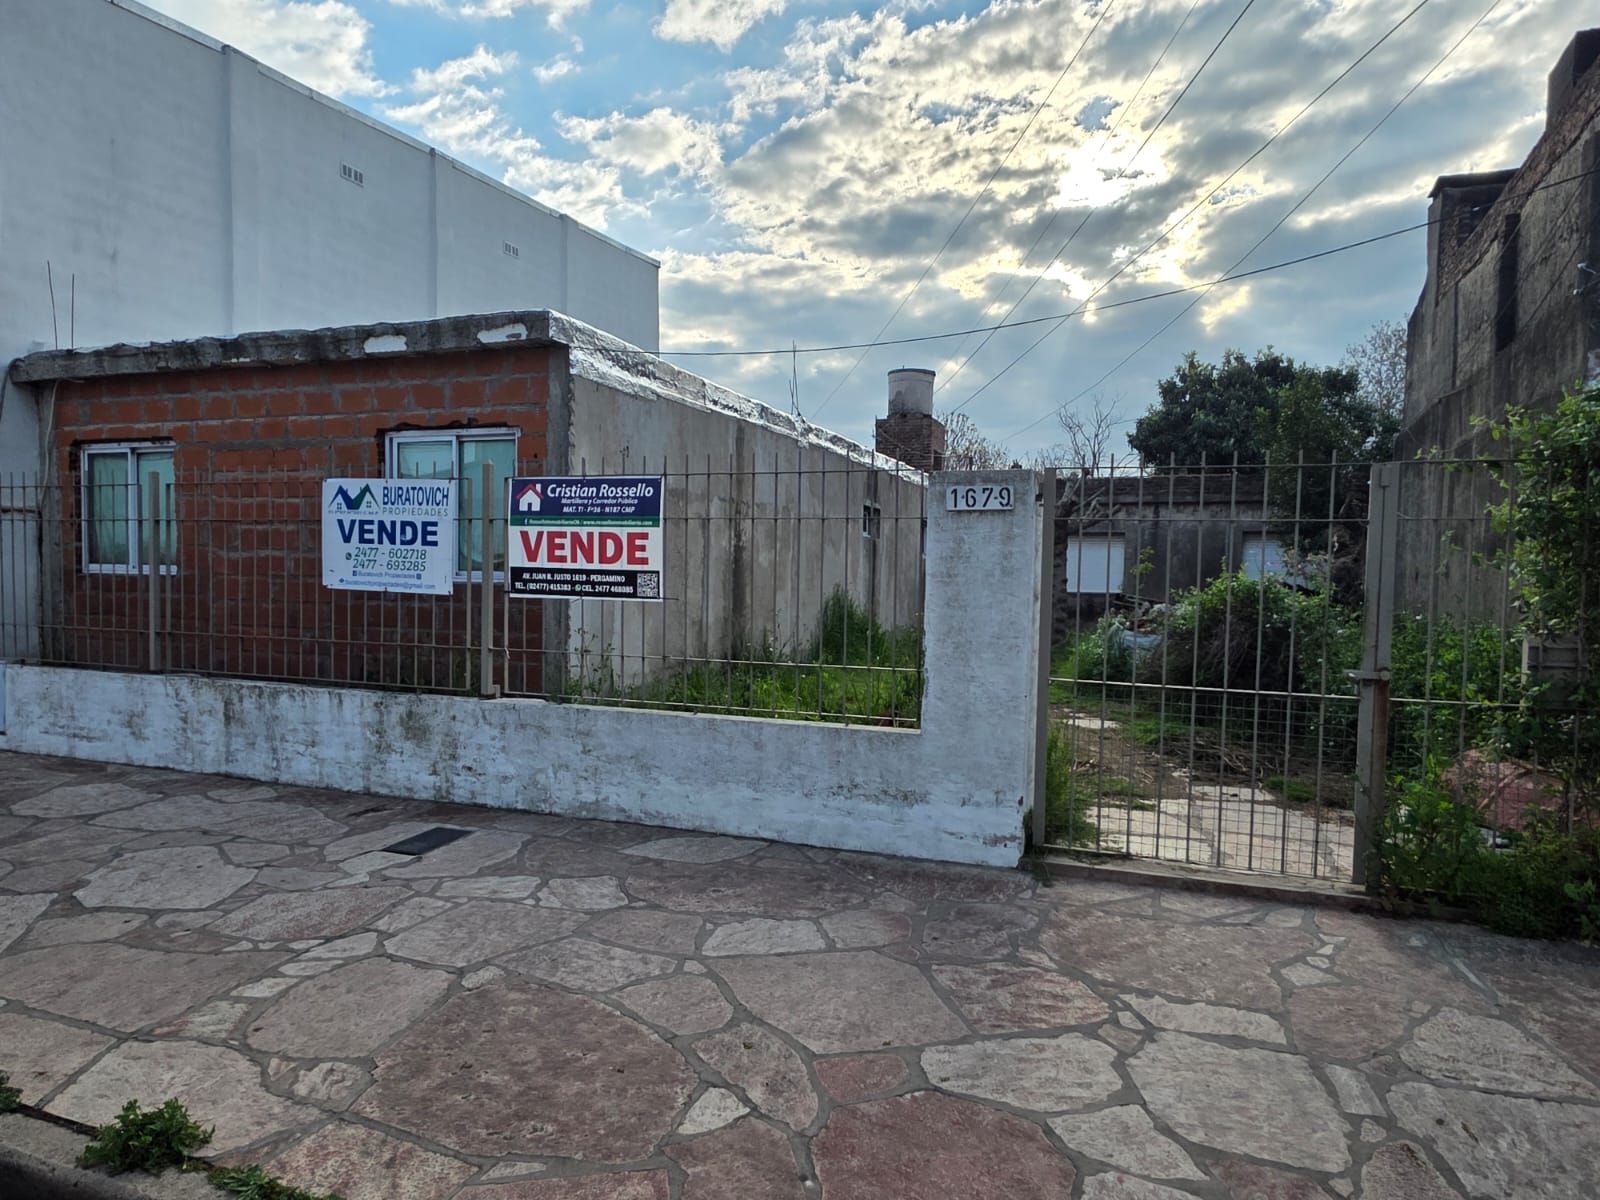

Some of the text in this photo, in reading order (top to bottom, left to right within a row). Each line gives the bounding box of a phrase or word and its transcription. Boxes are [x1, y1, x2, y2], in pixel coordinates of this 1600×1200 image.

[382, 487, 449, 506] BURATOVICH
[547, 484, 654, 498] Cristian Rossello
[951, 487, 1011, 508] 1679
[382, 507, 448, 517] PROPIEDADES
[337, 519, 438, 546] VENDE
[354, 547, 379, 558] 2477
[388, 548, 427, 560] 602718
[520, 531, 649, 565] VENDE
[352, 559, 376, 570] 2477
[386, 560, 426, 572] 693285
[591, 575, 625, 583] PERGAMINO
